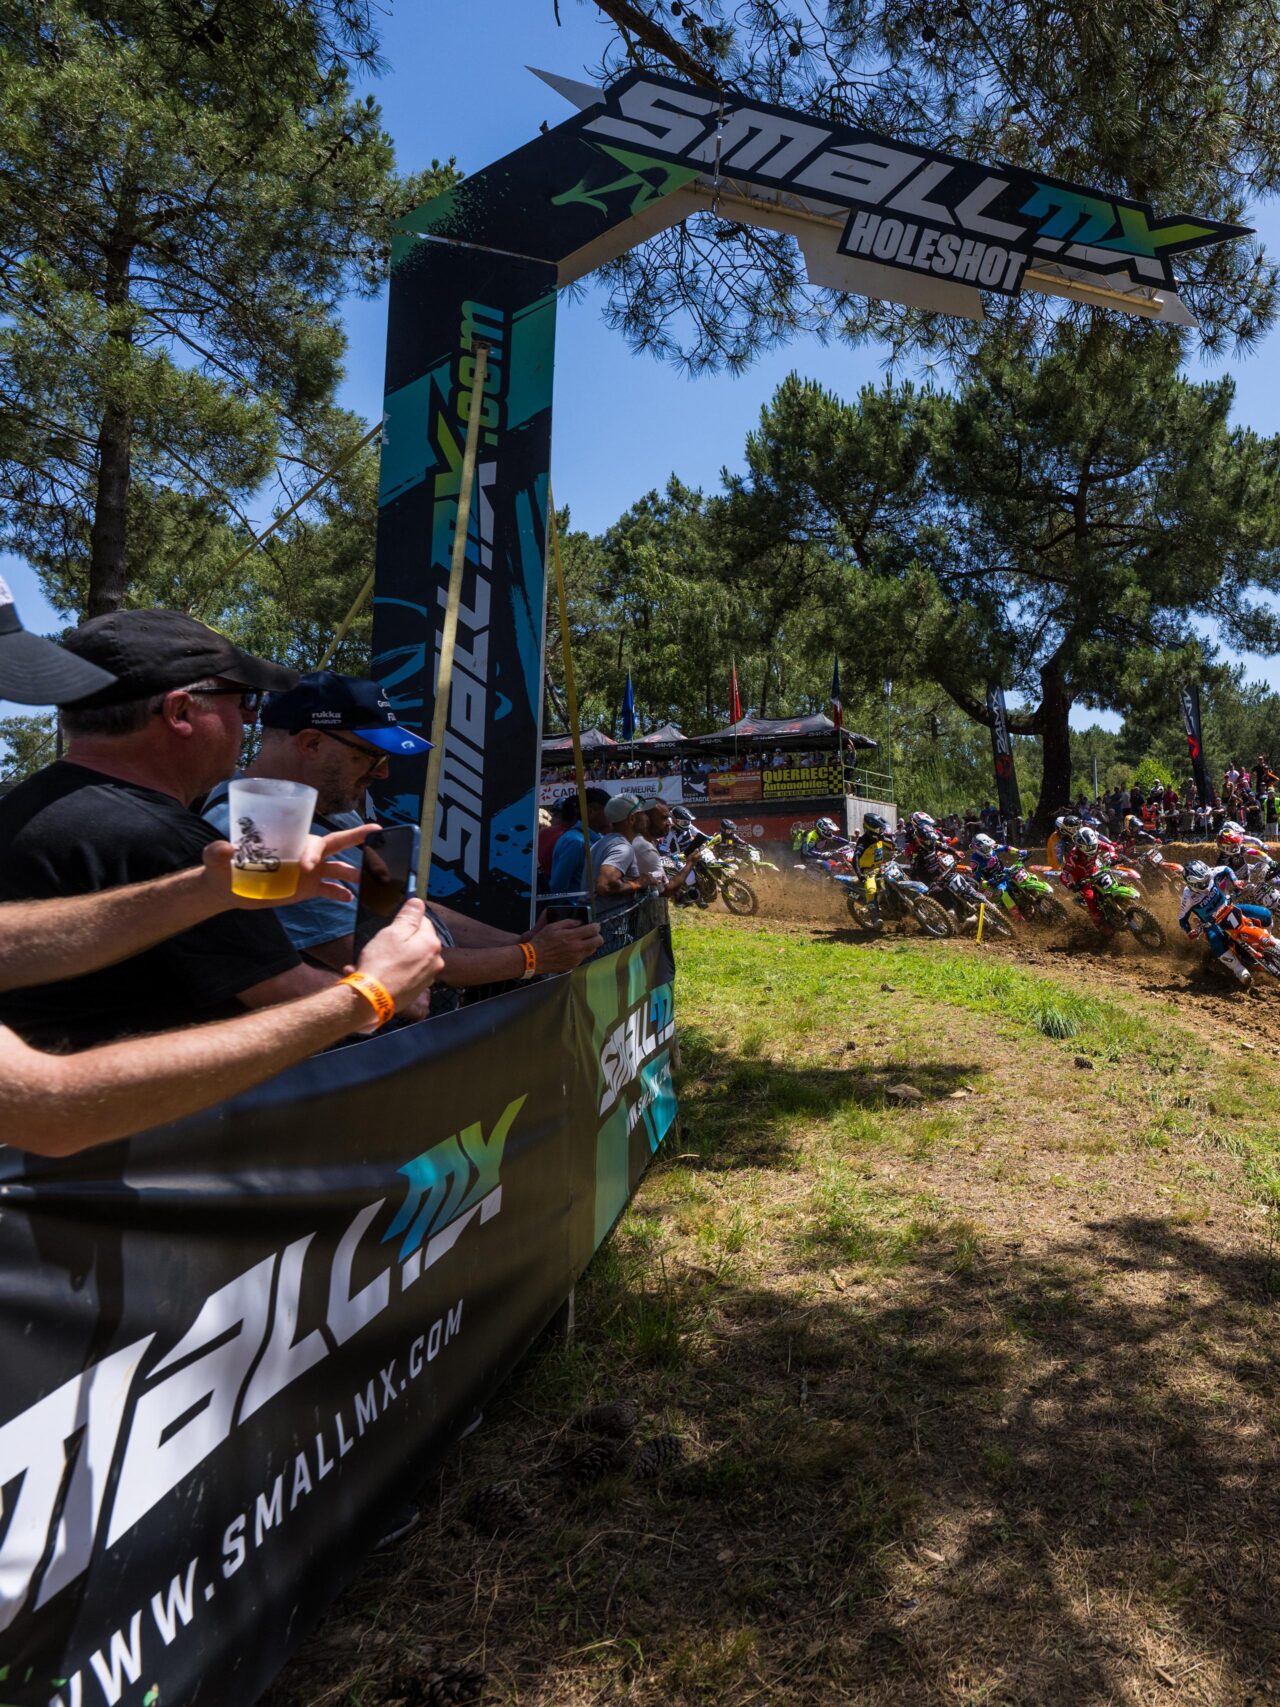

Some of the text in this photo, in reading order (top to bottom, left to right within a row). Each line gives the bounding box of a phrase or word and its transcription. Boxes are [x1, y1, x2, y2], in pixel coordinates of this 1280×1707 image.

[847, 212, 1028, 291] HOLESHOT
[763, 767, 829, 783] QUERREC
[763, 780, 829, 792] Automobiles
[1100, 873, 1113, 890] 3
[1226, 912, 1240, 929] 1
[50, 1299, 464, 1707] WW.SMALLMX.COM
